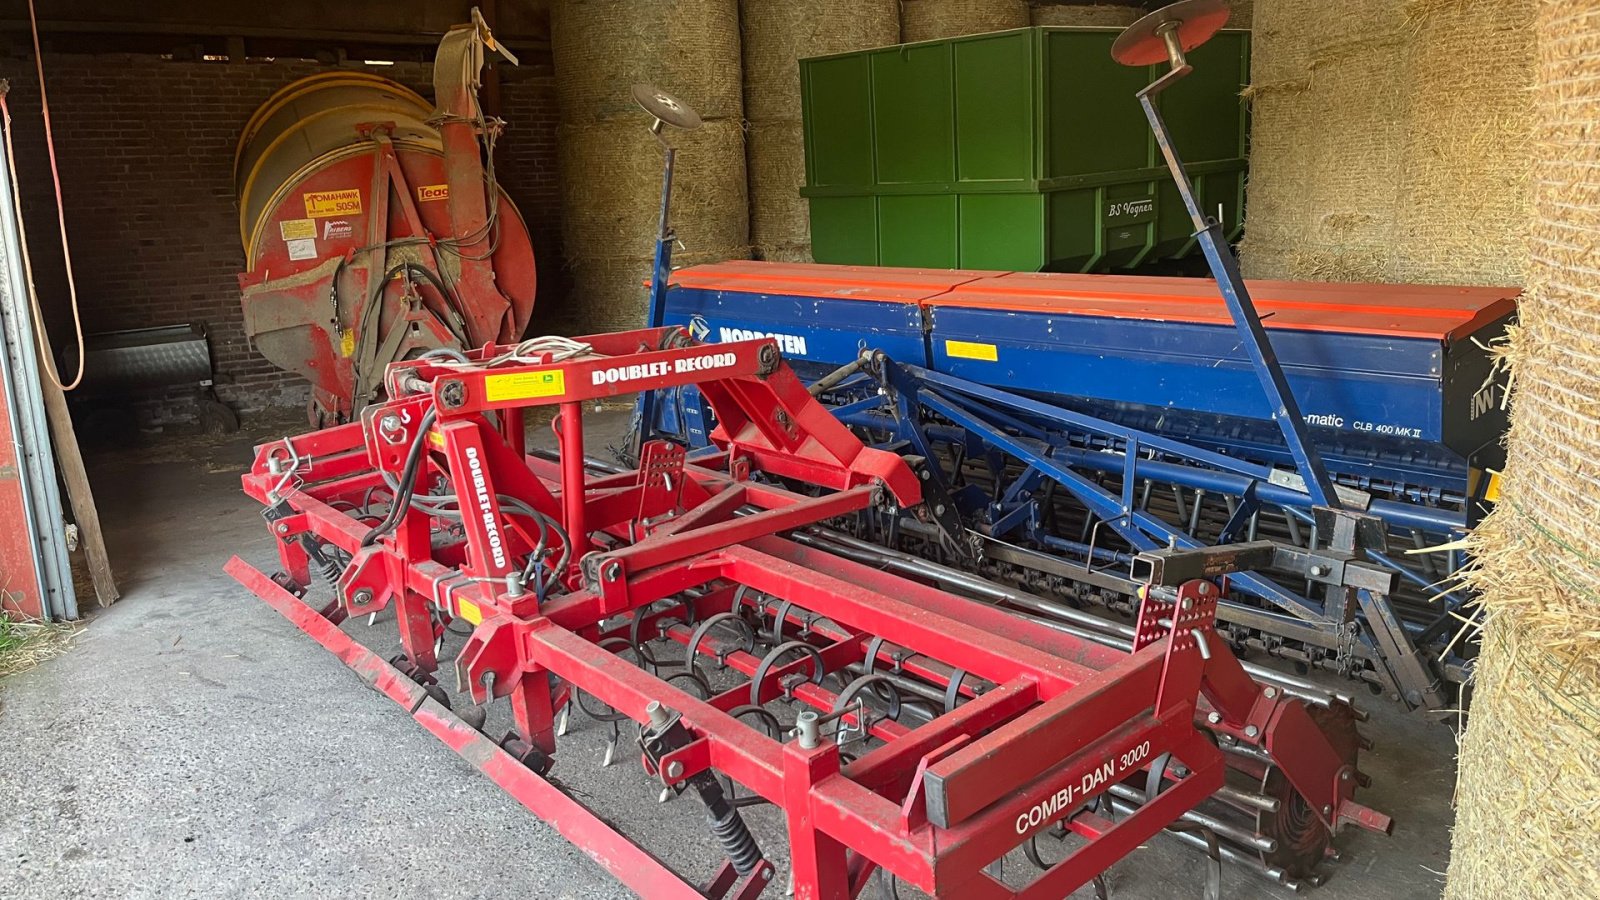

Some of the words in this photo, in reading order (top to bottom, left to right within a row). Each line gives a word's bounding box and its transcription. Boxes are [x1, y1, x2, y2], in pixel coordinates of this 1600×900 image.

[1109, 204, 1122, 217] BS
[1123, 199, 1153, 218] Vognen
[674, 352, 737, 374] RECORD
[1353, 421, 1373, 432] CLB
[1375, 424, 1393, 434] 400
[1395, 426, 1411, 437] MK
[1015, 759, 1115, 835] COMBI-DAN
[1119, 740, 1150, 772] 3000
